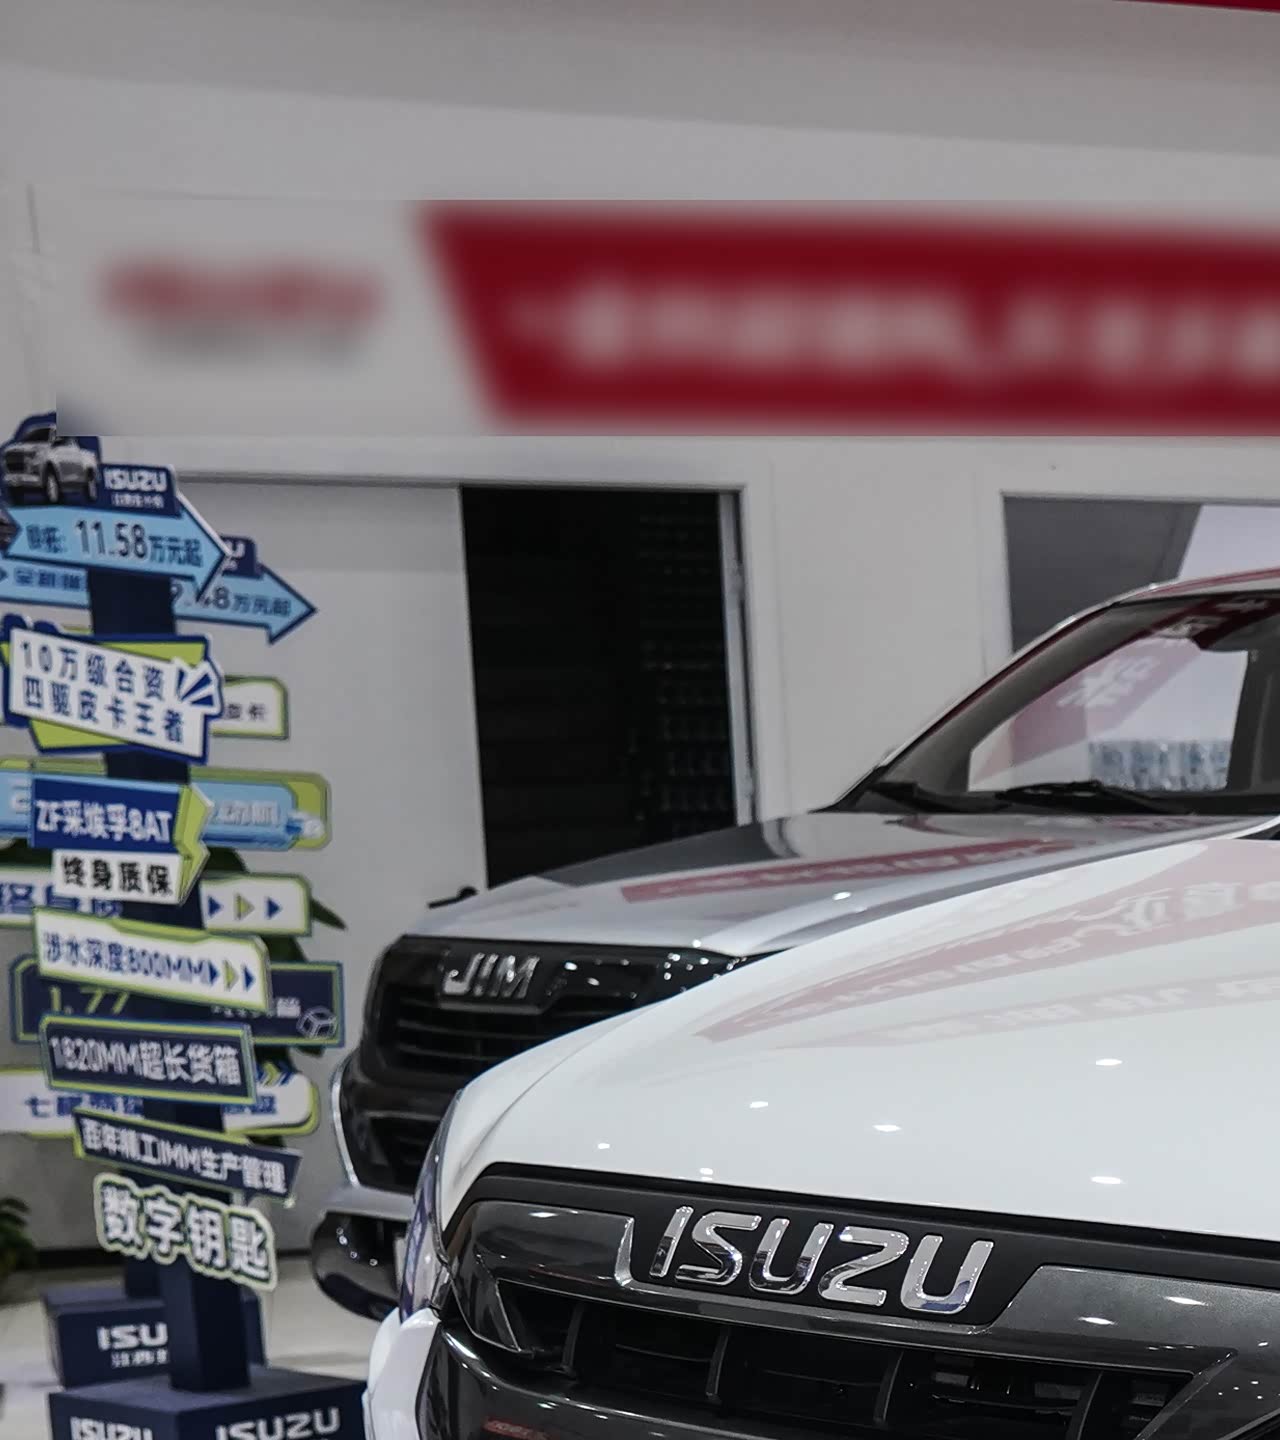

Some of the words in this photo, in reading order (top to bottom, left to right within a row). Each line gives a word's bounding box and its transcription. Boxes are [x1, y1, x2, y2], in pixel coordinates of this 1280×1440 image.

[103, 468, 167, 491] ISUZU
[20, 642, 164, 700] 10万级合资
[24, 675, 184, 743] 四驱皮卡王者
[36, 799, 173, 844] ZF采埃孚8AT
[62, 855, 174, 897] 终身质保
[101, 1184, 273, 1280] 数字钥匙
[649, 1205, 995, 1314] ISUZU
